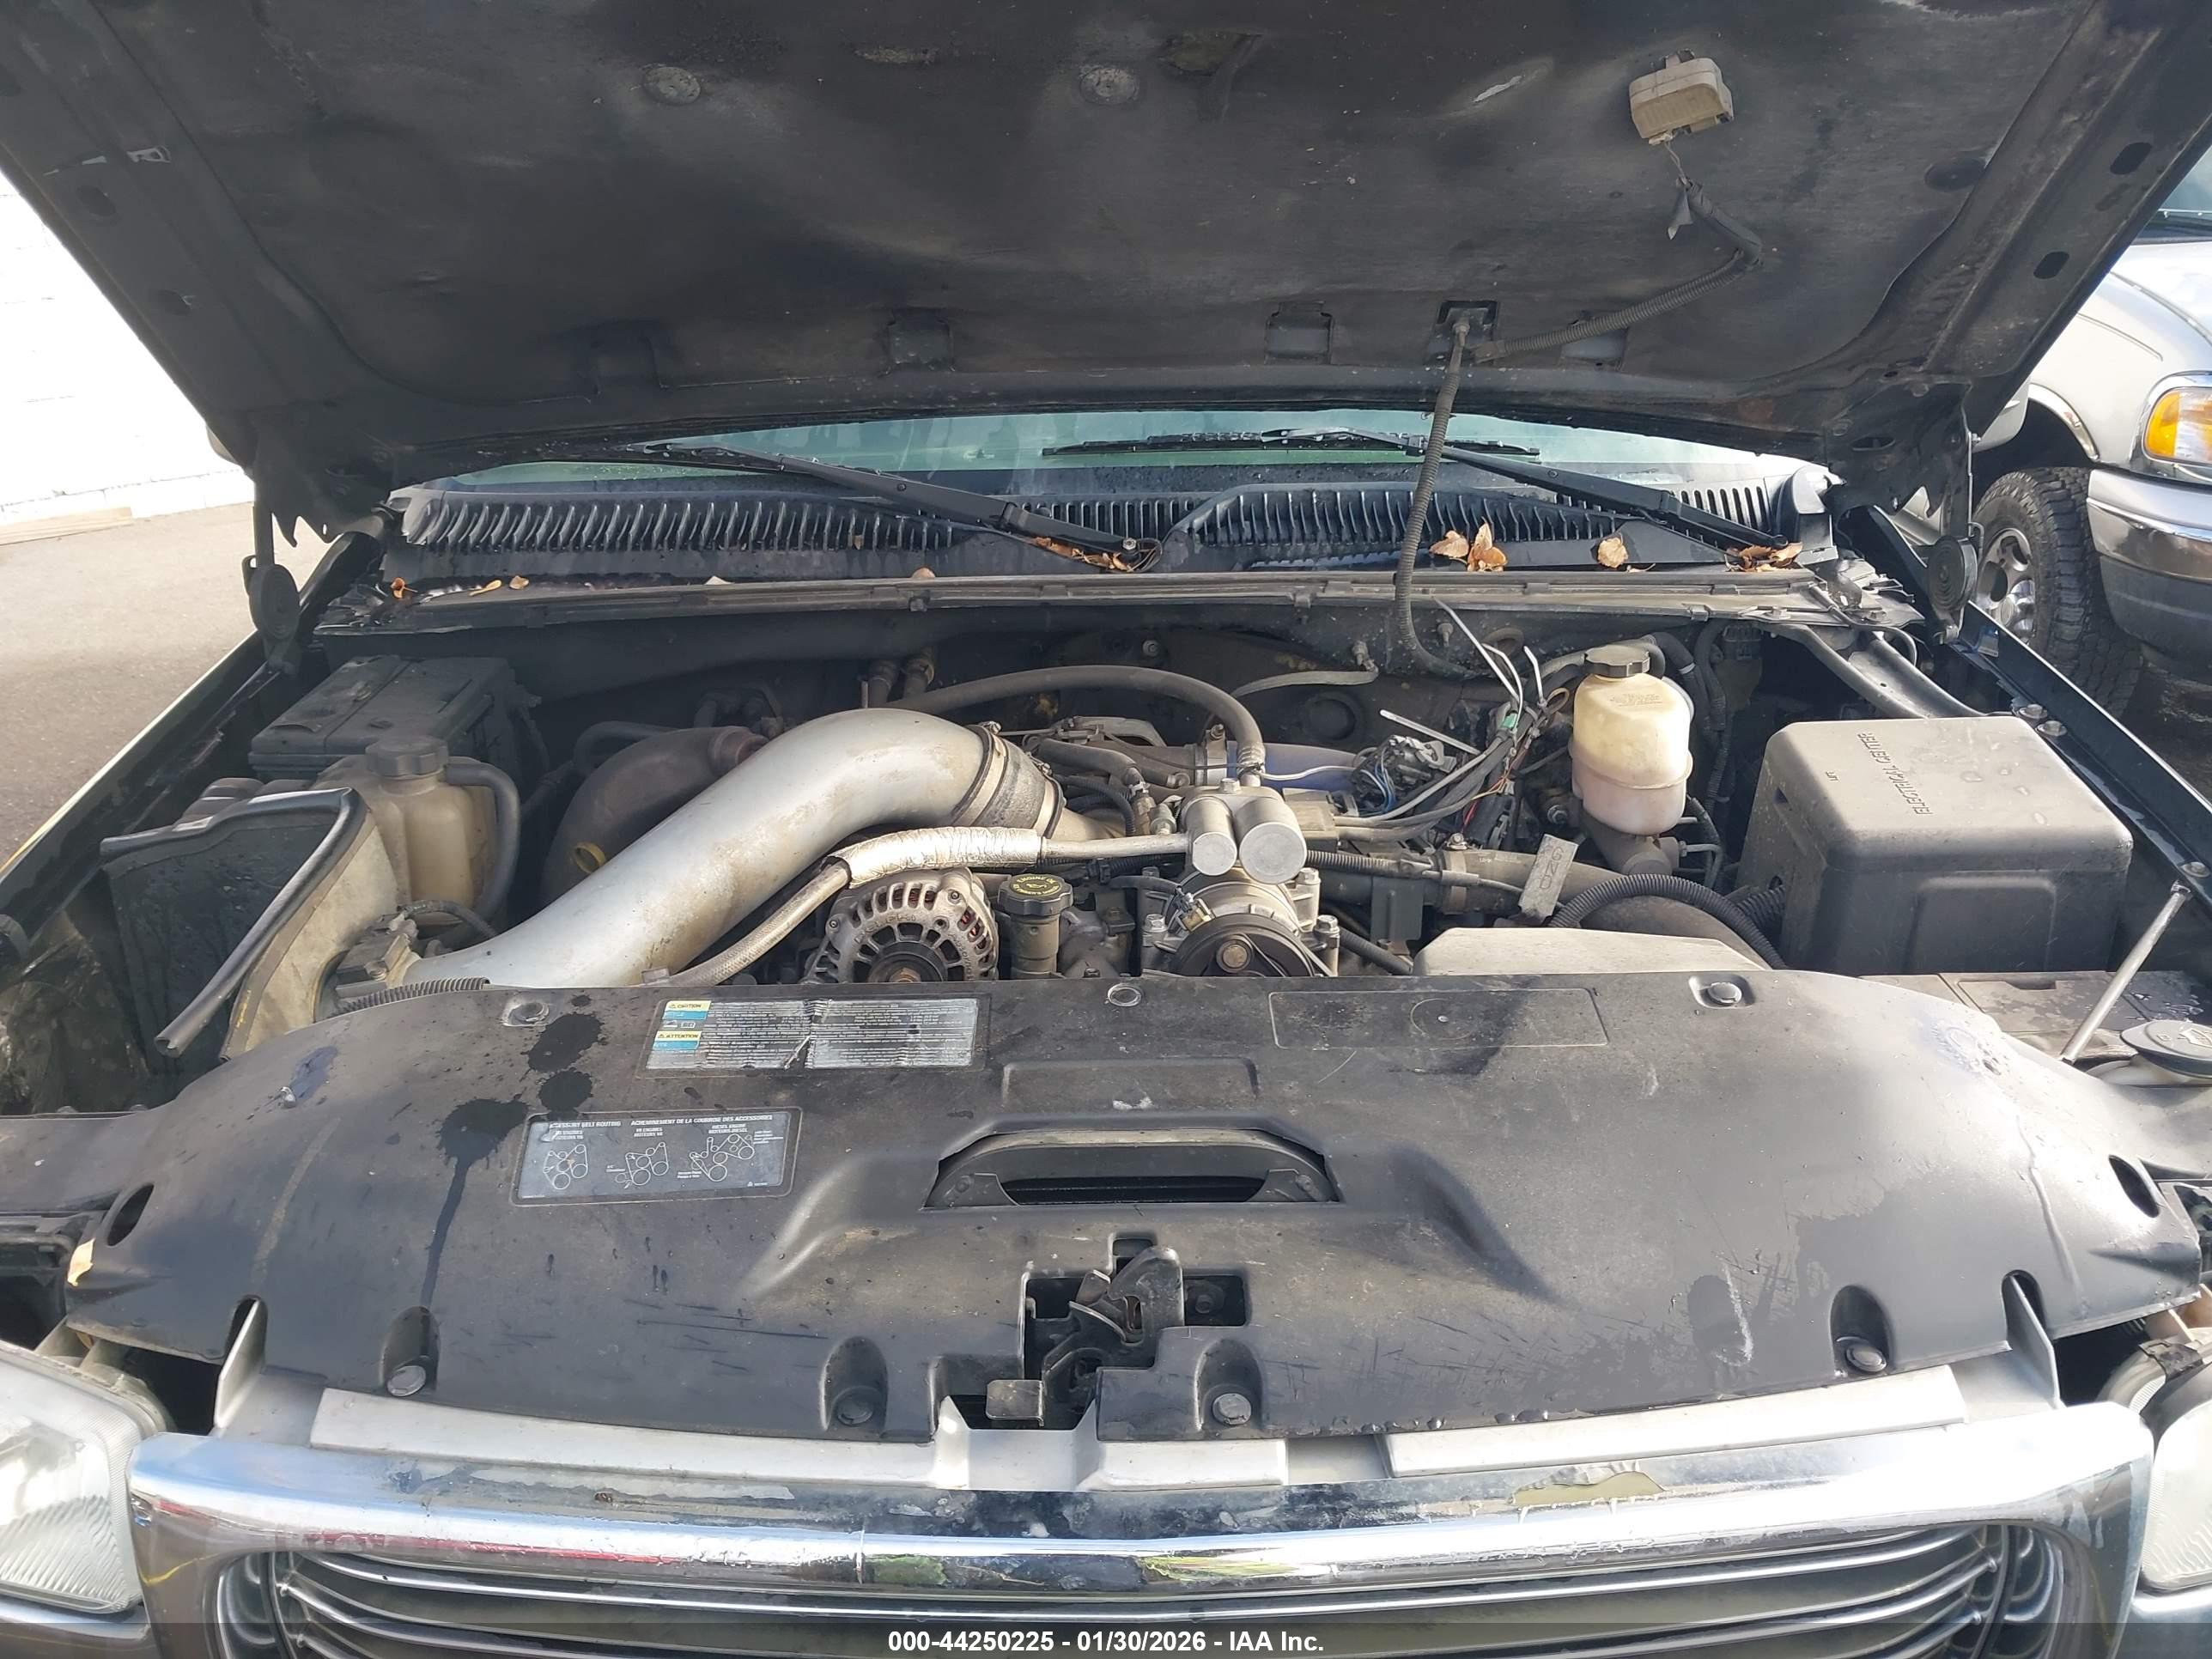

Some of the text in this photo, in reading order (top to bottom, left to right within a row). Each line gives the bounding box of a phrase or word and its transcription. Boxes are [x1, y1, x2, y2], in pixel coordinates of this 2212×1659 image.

[1857, 732, 1934, 815] ELECTRICAL CENTER
[1539, 847, 1565, 890] GND
